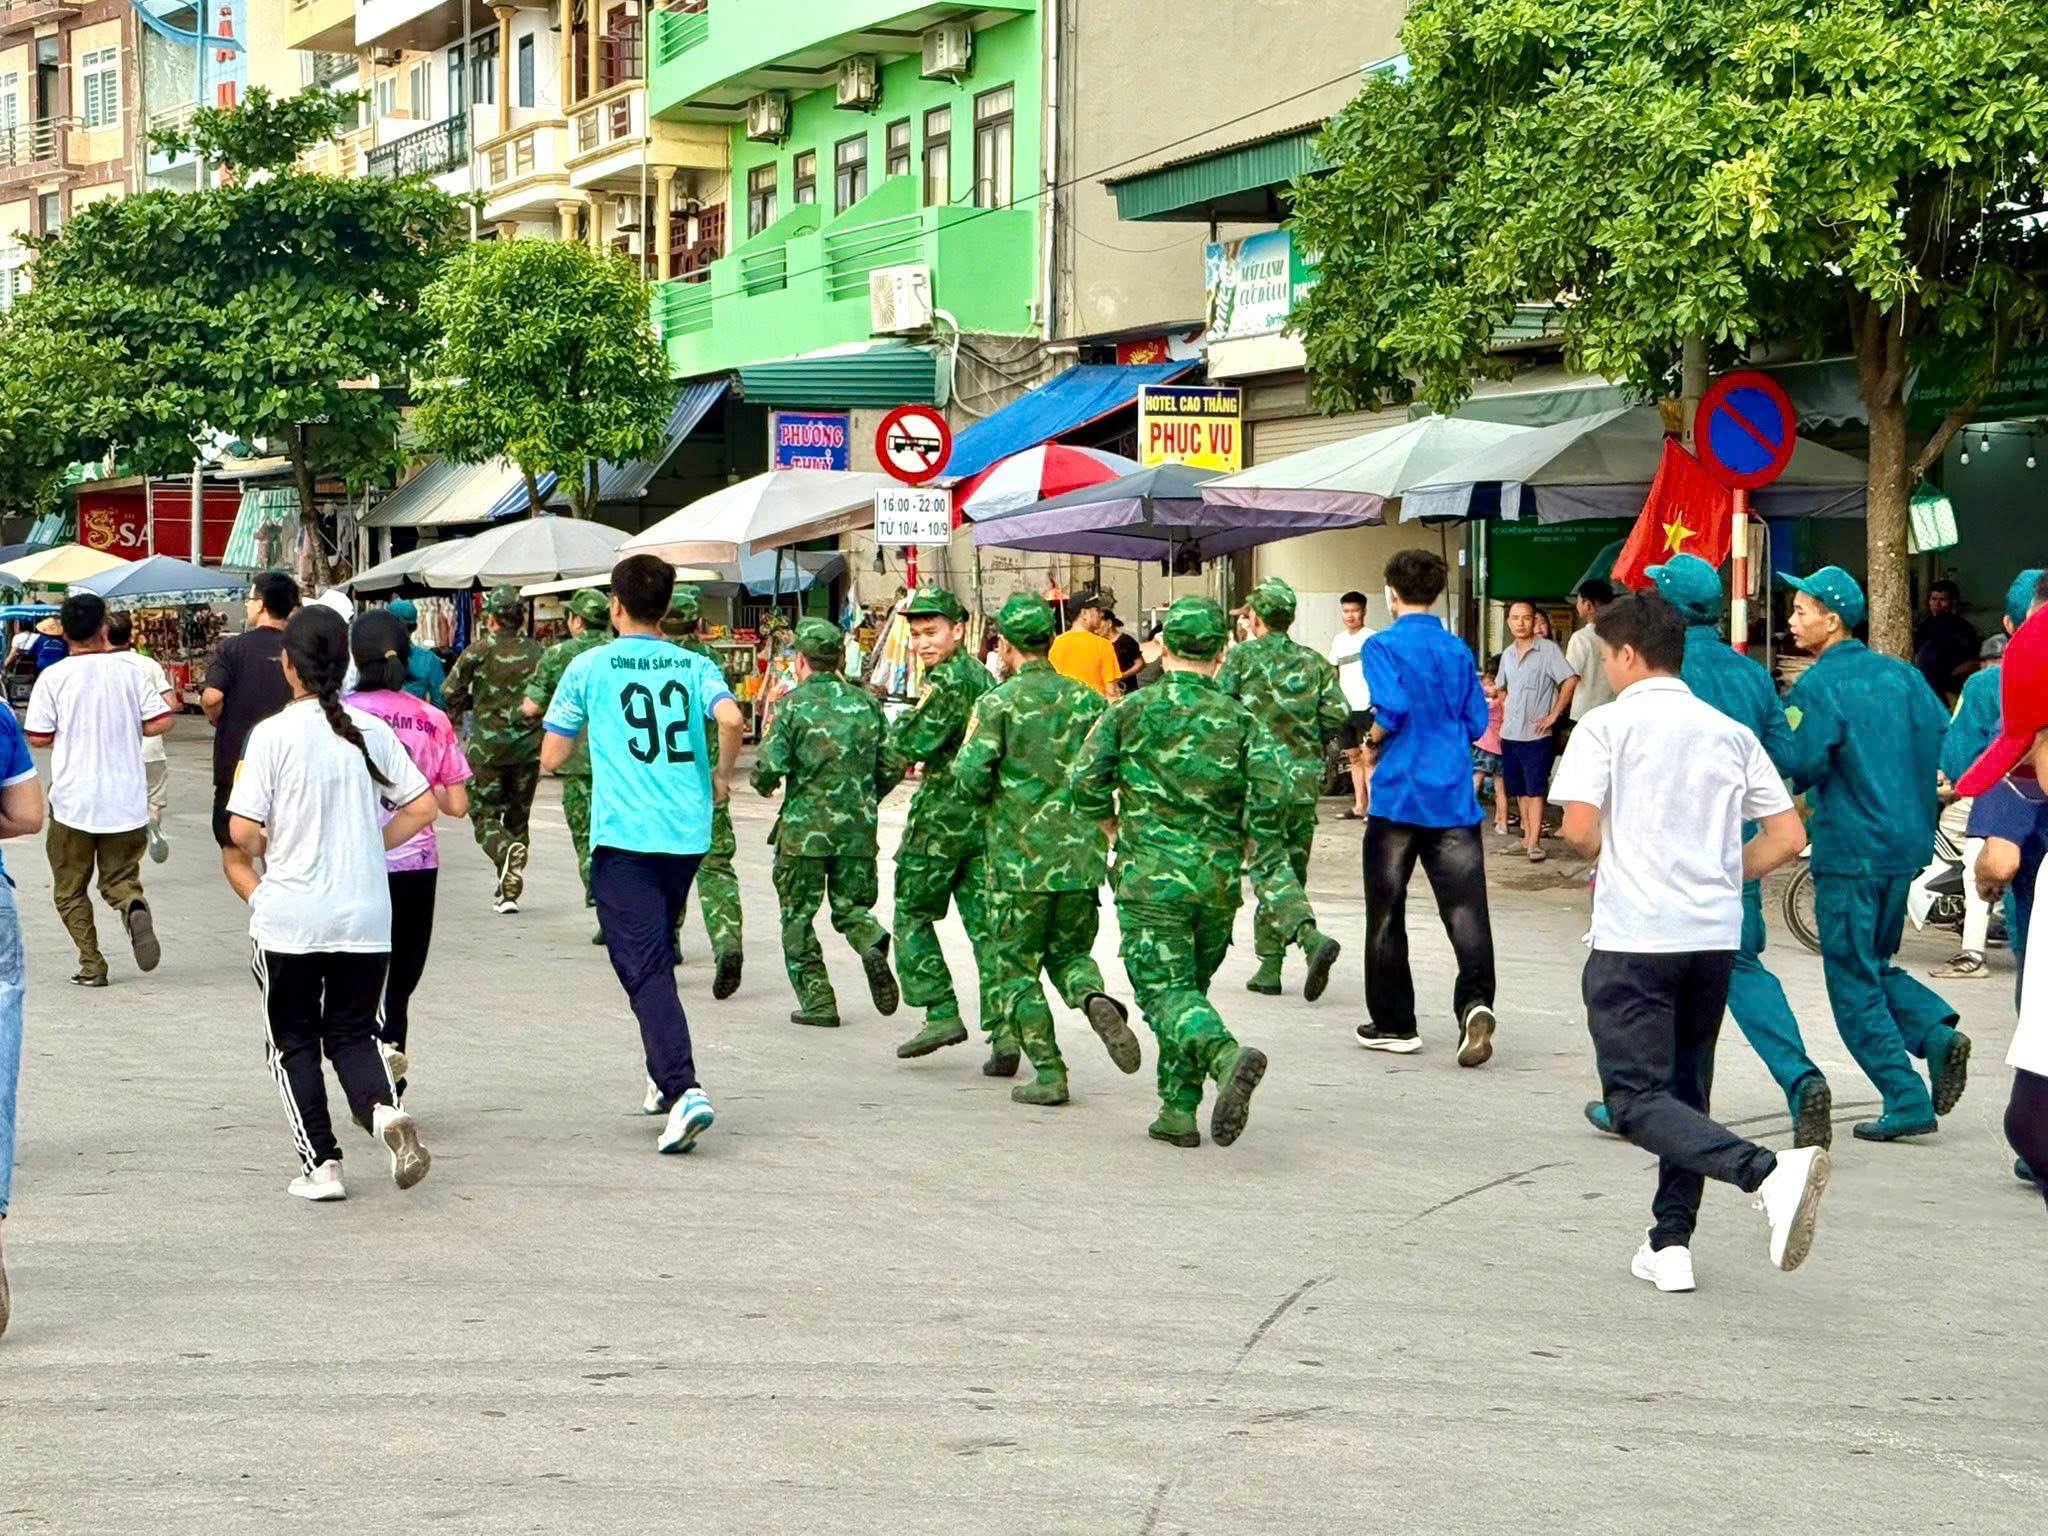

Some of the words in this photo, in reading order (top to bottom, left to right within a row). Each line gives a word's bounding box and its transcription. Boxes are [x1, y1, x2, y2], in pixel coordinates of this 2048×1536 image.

[1145, 395, 1177, 412] HOTEL
[1180, 396, 1201, 412] CAO
[1150, 422, 1202, 461] PHỤC
[1208, 423, 1232, 462] VỤ
[883, 498, 909, 512] 16:00
[919, 498, 946, 512] 22:00
[899, 521, 918, 535] 10/4
[928, 521, 948, 535] 10/9
[637, 657, 650, 670] AN
[620, 680, 696, 764] 92
